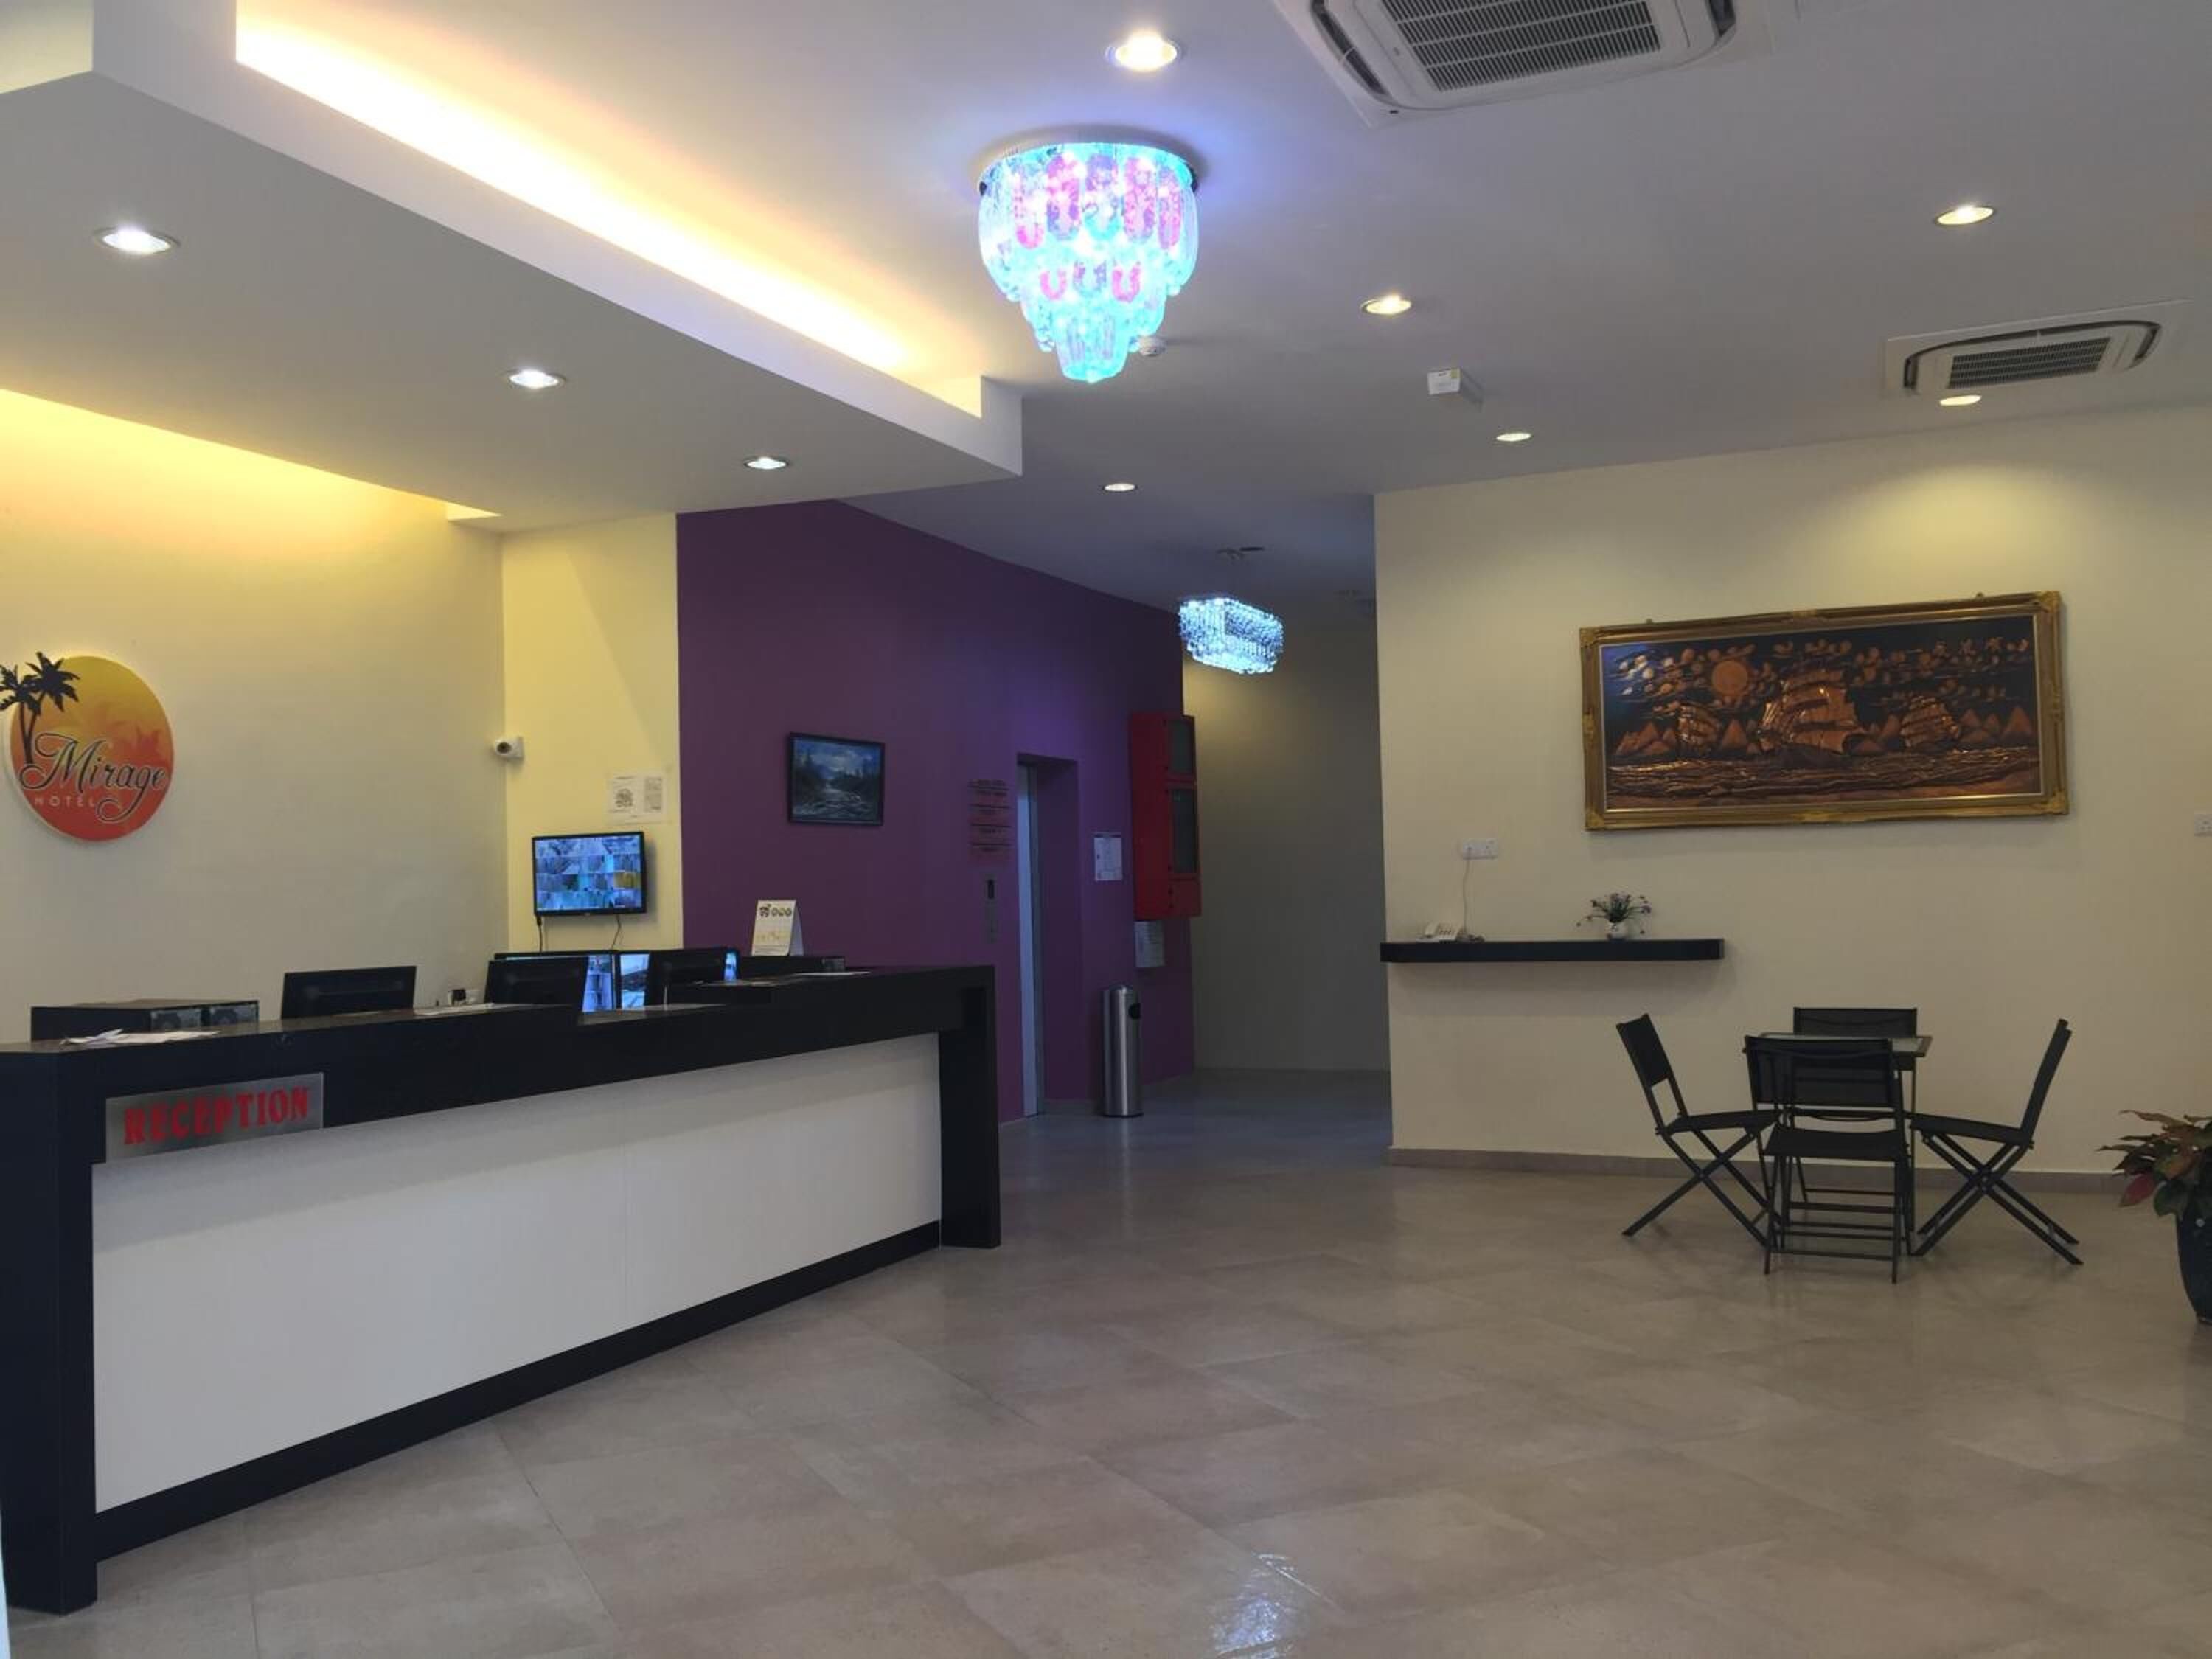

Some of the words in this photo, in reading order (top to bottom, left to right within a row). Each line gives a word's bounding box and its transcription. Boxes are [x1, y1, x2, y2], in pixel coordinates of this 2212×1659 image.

[19, 732, 167, 824] Mirage
[35, 795, 95, 807] HOTEL
[124, 1085, 311, 1145] RECEPTION
